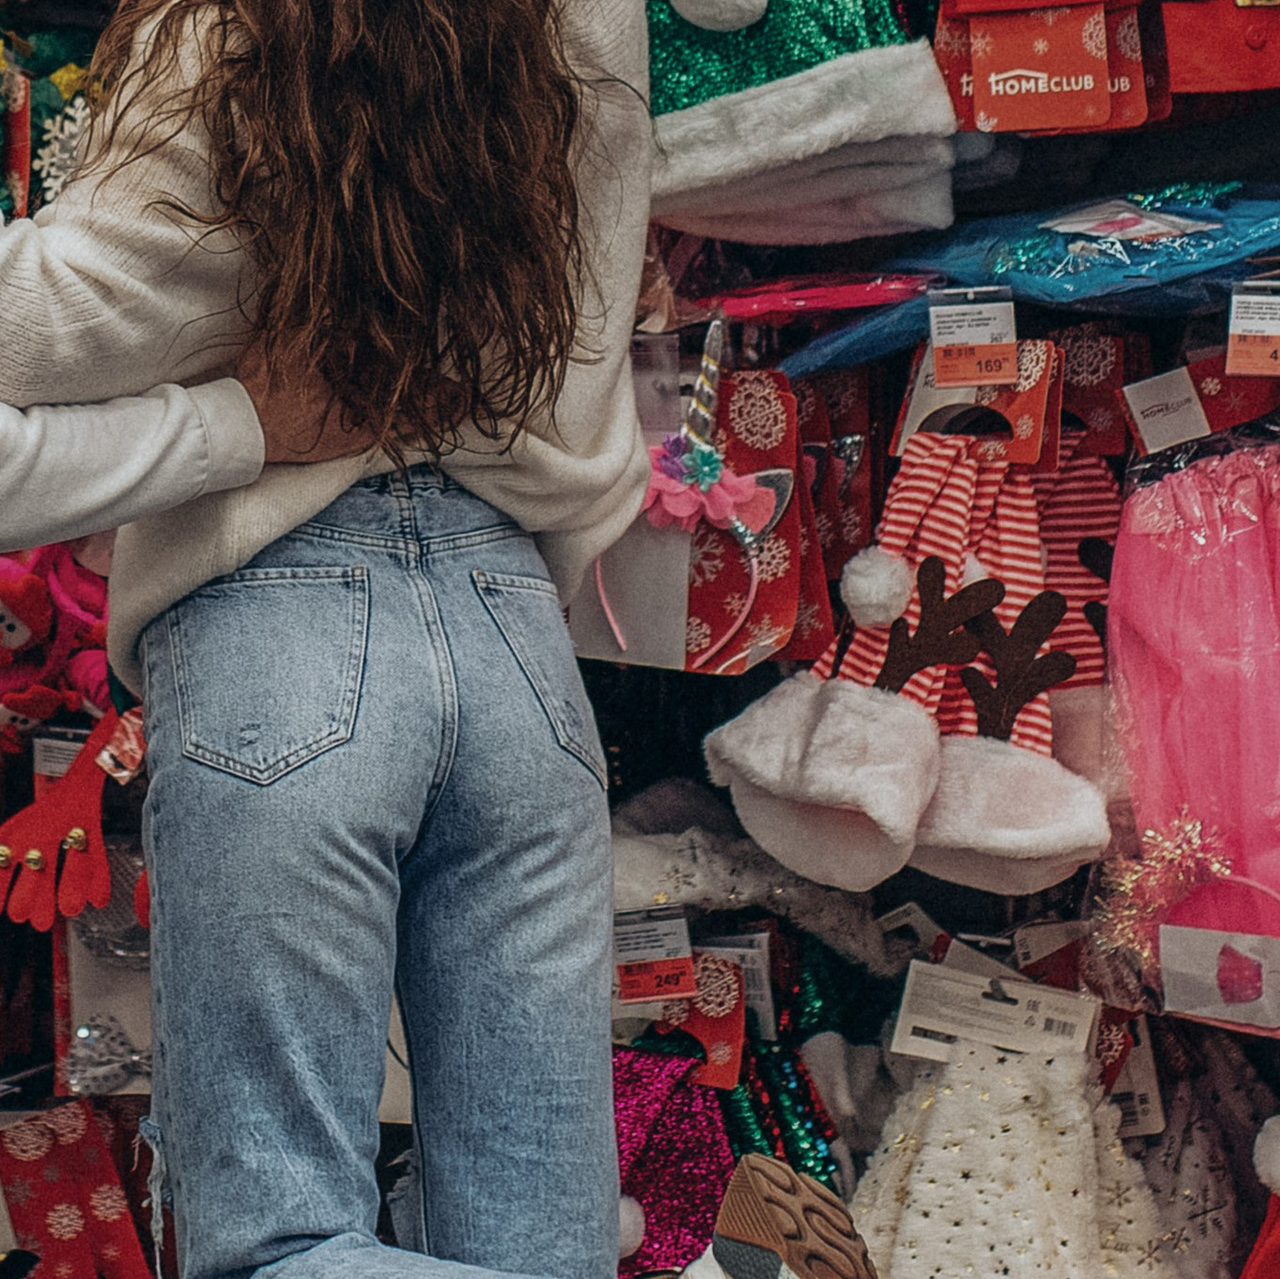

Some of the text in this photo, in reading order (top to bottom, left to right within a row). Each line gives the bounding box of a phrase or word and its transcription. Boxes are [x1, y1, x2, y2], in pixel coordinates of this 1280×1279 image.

[989, 70, 1094, 95] HOMECLUB
[976, 359, 1002, 373] 169
[1140, 398, 1193, 420] HOMECLUB
[654, 974, 680, 988] 249
